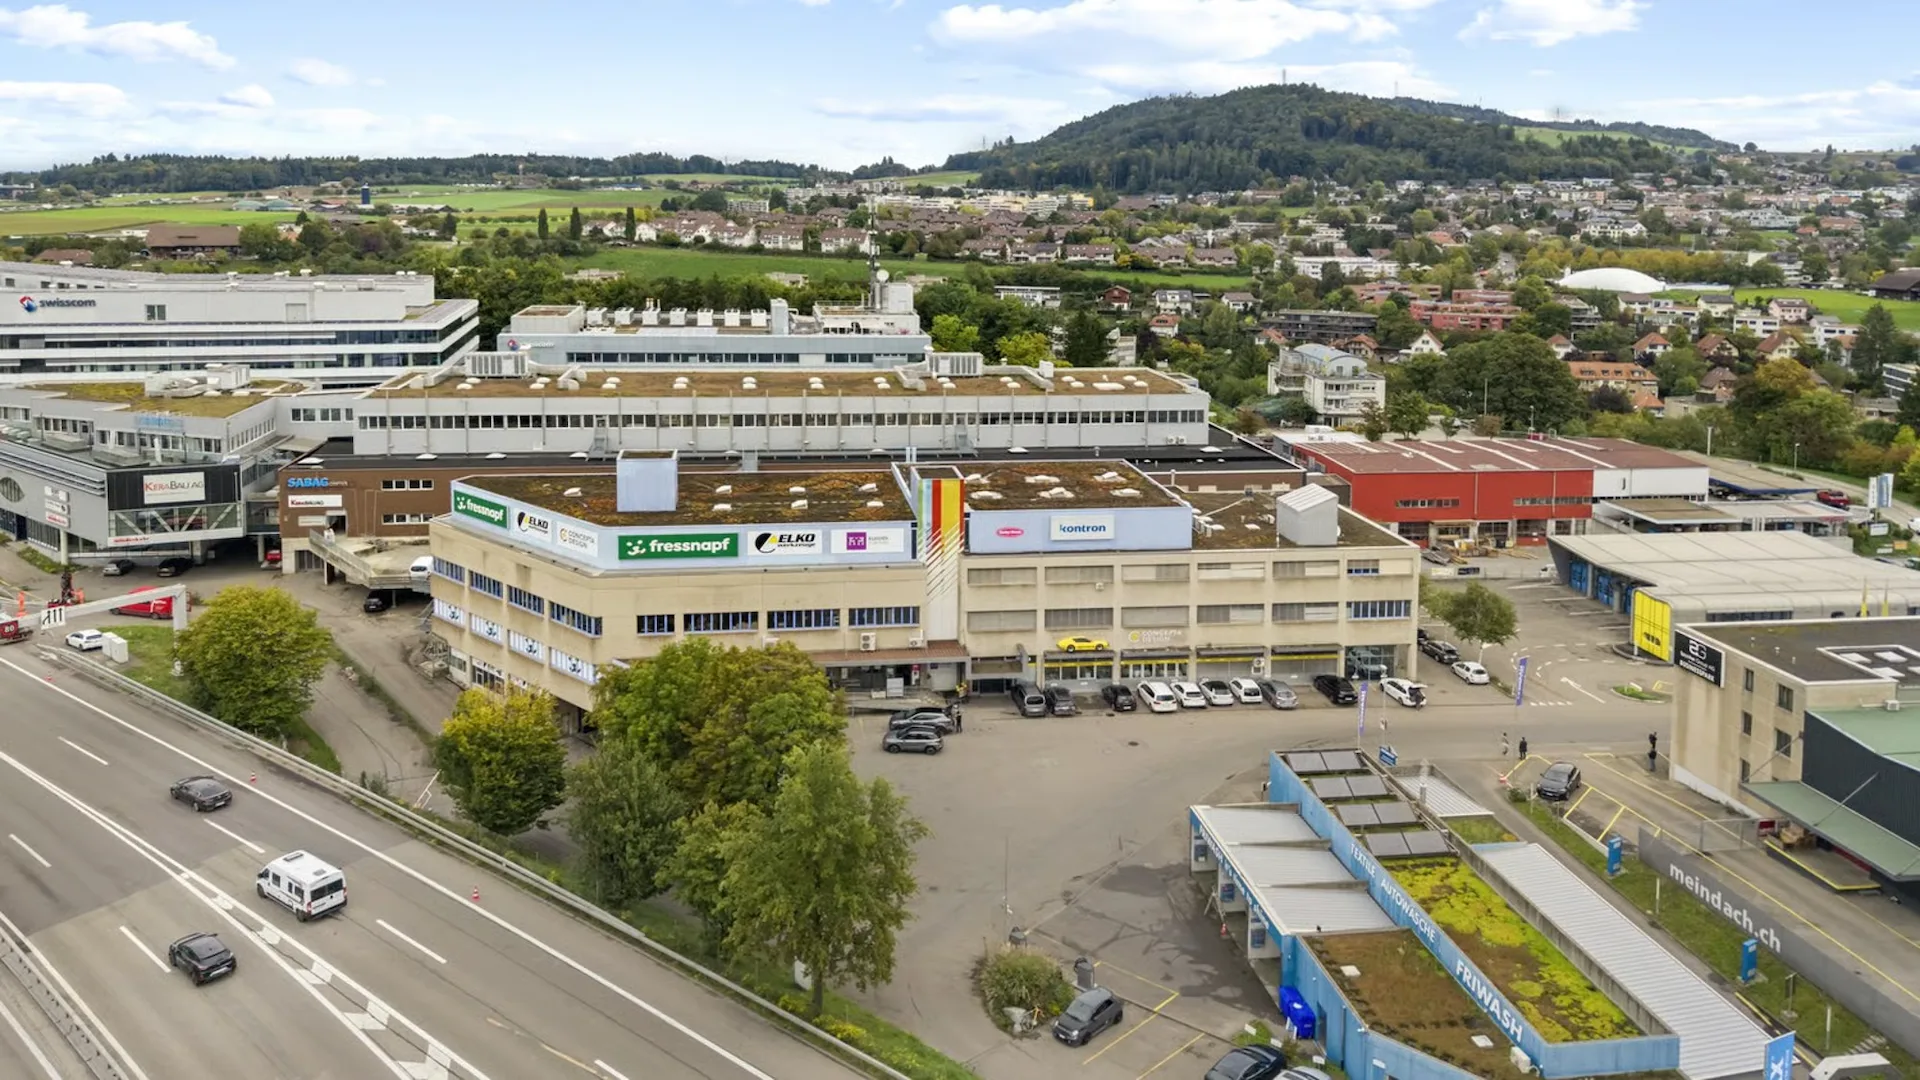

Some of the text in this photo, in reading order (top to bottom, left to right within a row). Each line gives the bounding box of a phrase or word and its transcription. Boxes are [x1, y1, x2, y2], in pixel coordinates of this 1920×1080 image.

[39, 298, 96, 307] swisscom
[287, 478, 329, 488] SABAG
[467, 500, 504, 522] fressnapf
[529, 516, 549, 529] ELKO
[1059, 524, 1106, 533] kontron
[649, 538, 731, 553] fressnapf
[778, 534, 816, 543] ELKO
[1350, 843, 1436, 943] TEXTILE AUTOWASCHE
[1669, 863, 1781, 954] meindach.ch
[1456, 959, 1523, 1043] FRIWASH
